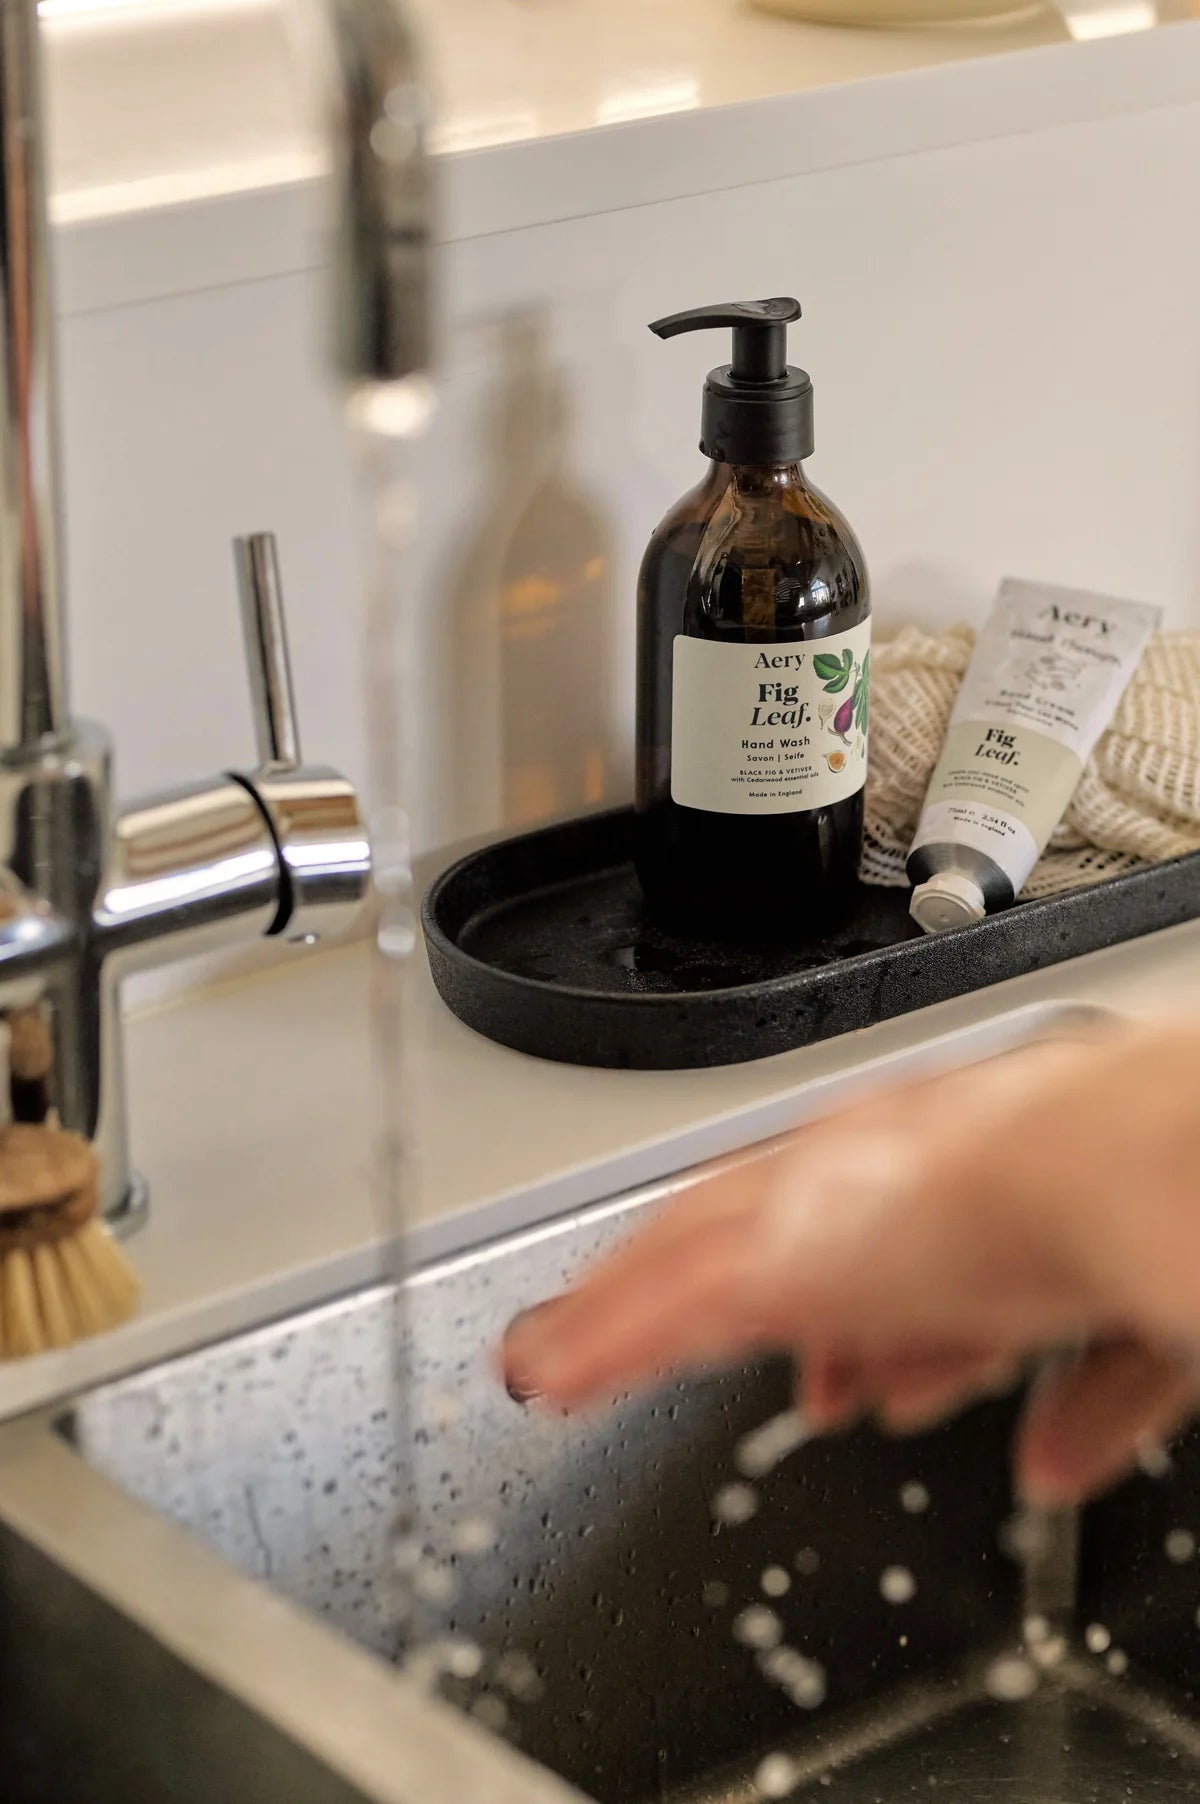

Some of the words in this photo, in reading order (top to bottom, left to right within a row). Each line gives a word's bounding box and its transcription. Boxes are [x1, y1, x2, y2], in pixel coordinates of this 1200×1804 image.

[1037, 604, 1118, 638] Aery
[754, 653, 805, 671] Aery
[758, 683, 799, 706] Fig
[750, 703, 811, 729] Leaf.
[741, 739, 774, 749] Hand
[780, 736, 810, 748] Wash
[984, 728, 1017, 749] Fig
[747, 754, 774, 762] Savon
[784, 752, 804, 761] Seife
[974, 743, 1020, 766] Leaf.
[784, 774, 809, 782] essential
[786, 766, 812, 775] VETIVER
[778, 789, 802, 798] England
